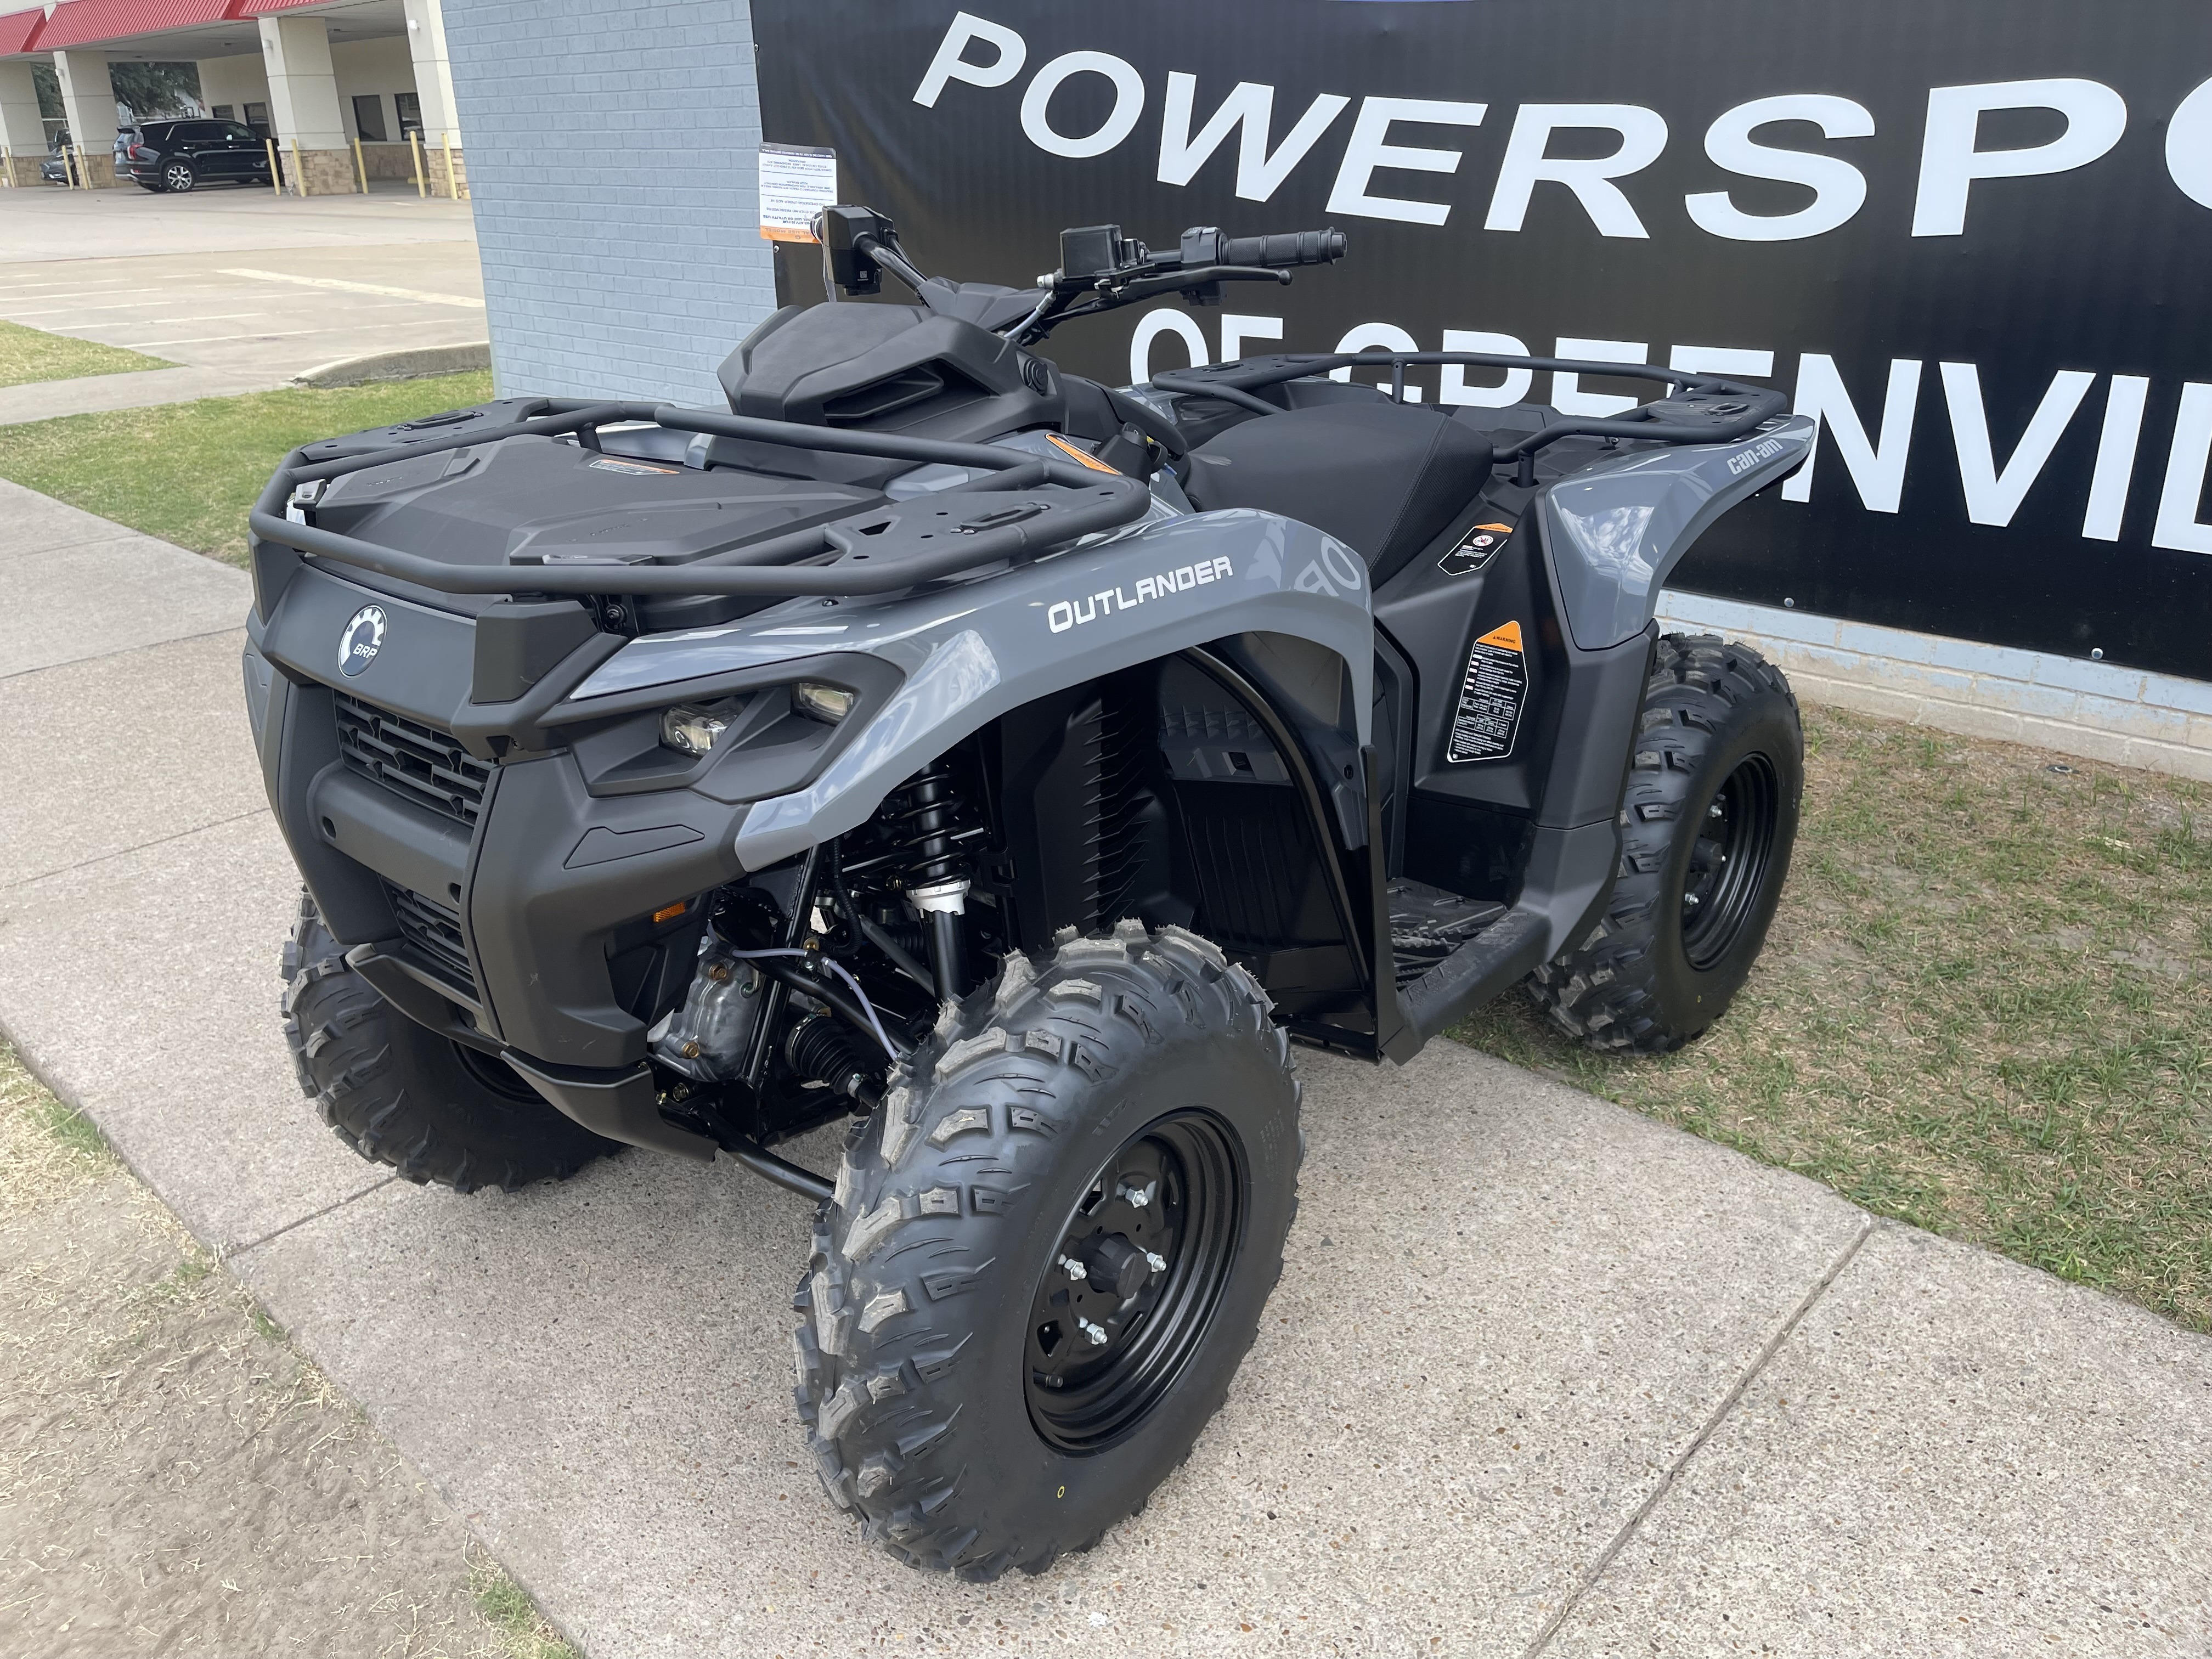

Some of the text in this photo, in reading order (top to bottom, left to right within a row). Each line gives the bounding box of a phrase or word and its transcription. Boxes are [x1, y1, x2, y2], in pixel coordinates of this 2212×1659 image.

[913, 12, 2212, 240] POWERSP
[1727, 439, 1784, 475] can-am
[1048, 556, 1233, 634] OUTLANDER
[353, 643, 377, 658] BRP
